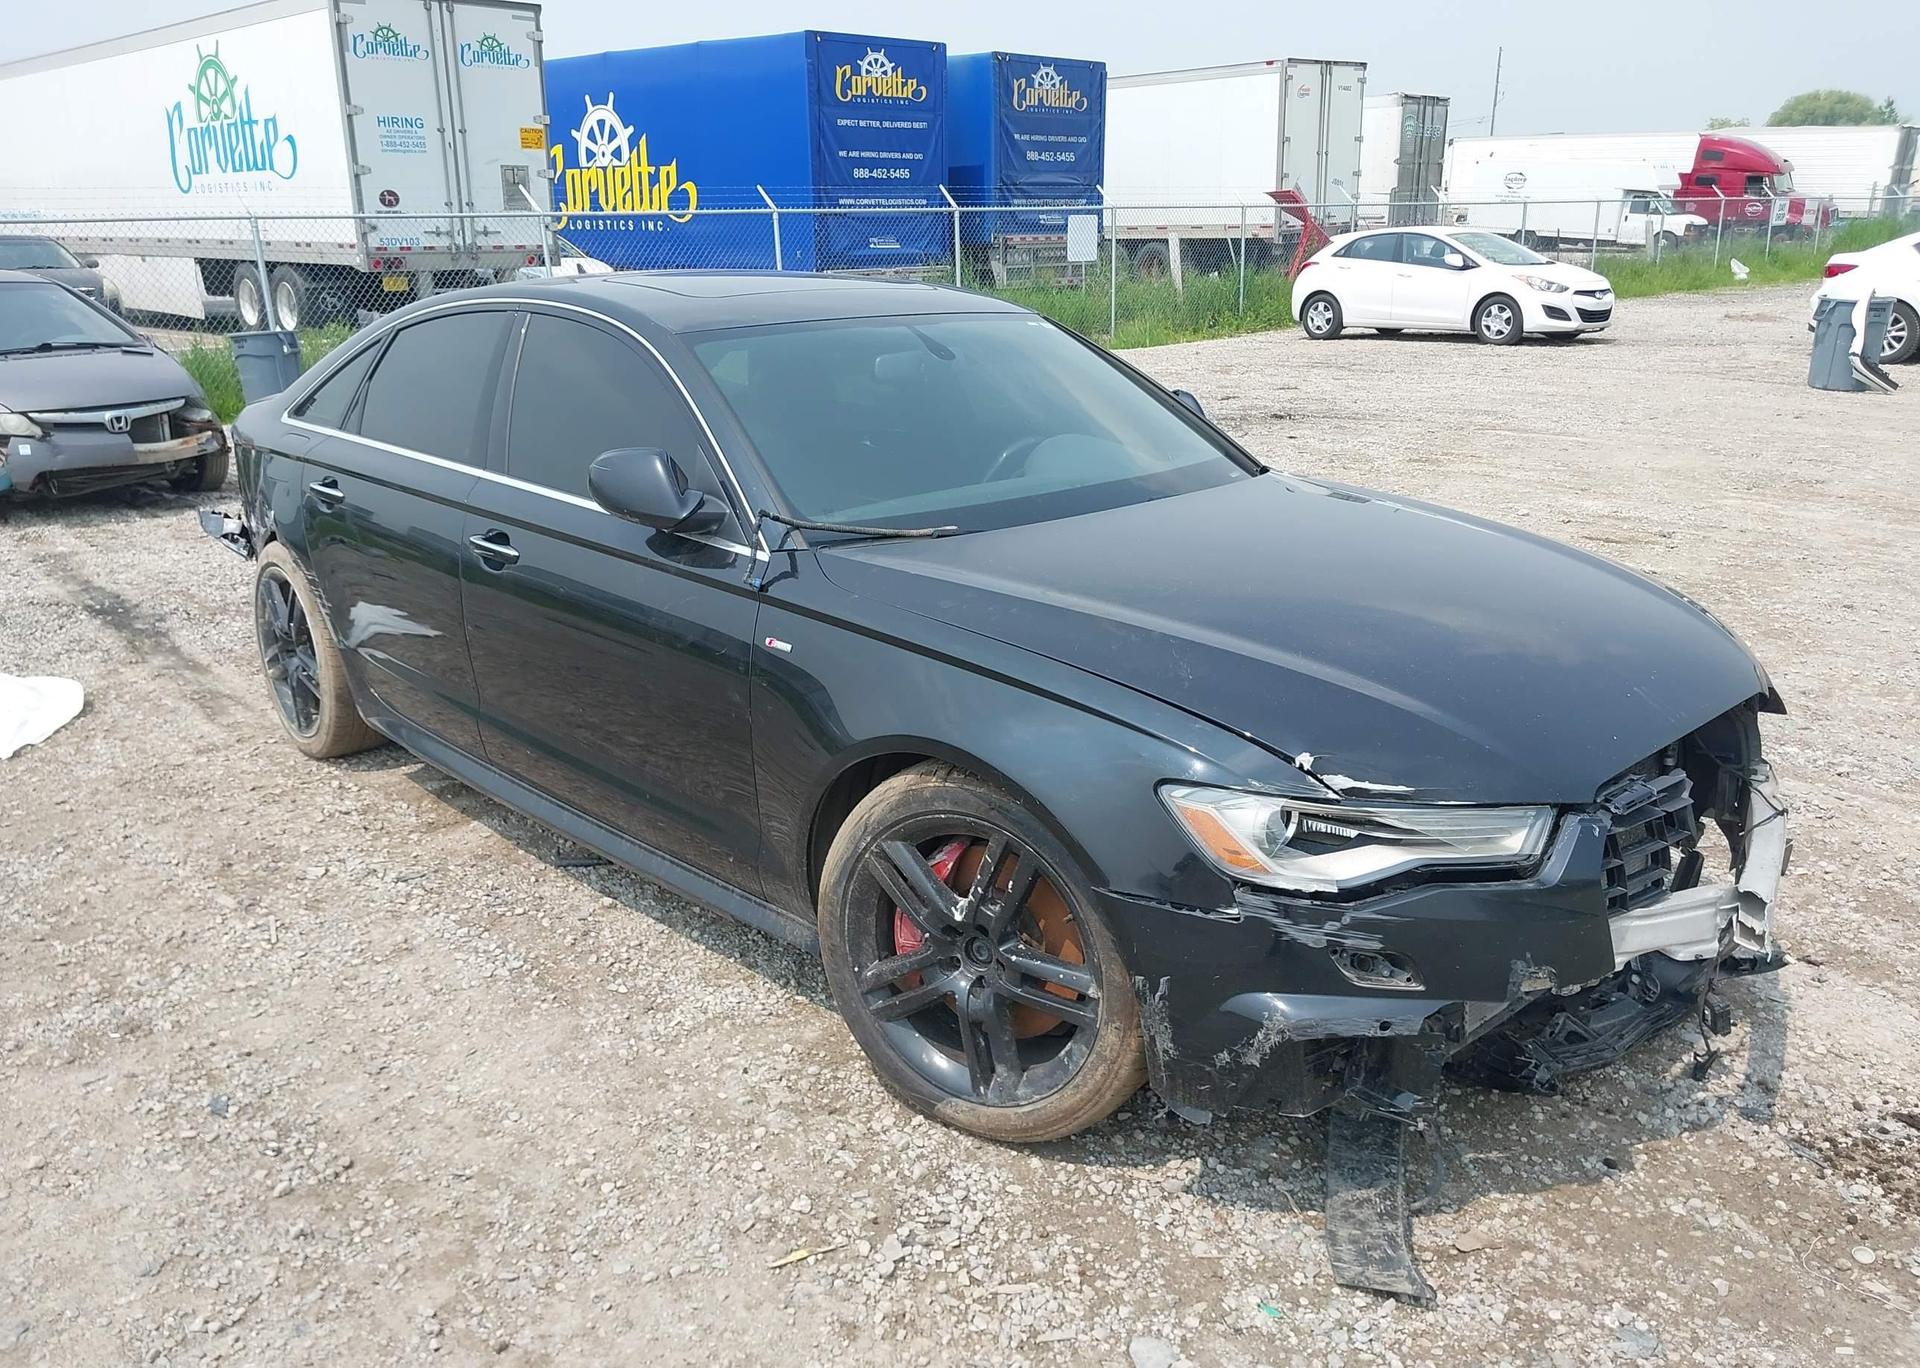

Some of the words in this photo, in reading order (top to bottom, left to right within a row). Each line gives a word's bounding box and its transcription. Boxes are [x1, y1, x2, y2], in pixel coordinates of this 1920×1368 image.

[352, 33, 429, 60] Corvette
[460, 42, 530, 67] Corvette
[835, 64, 927, 102] Corvette
[1013, 78, 1088, 112] Corvette
[377, 116, 424, 129] HIRING
[837, 118, 858, 127] EXPECT
[859, 119, 882, 129] BETTER,
[882, 121, 912, 129] DELIVERED
[165, 83, 298, 194] Corvette
[1030, 134, 1047, 142] HIRING
[838, 150, 847, 158] WE
[848, 150, 859, 158] ARE
[879, 151, 901, 159] DRIVERS
[1026, 151, 1075, 162] 888-452-5455
[853, 168, 910, 179] 888-452-5455
[194, 181, 249, 194] LOGISTICS
[838, 198, 927, 206] WWW.CORVETTELOGISTICS.COM
[569, 219, 634, 231] LOGISTICS
[641, 219, 670, 231] INC.
